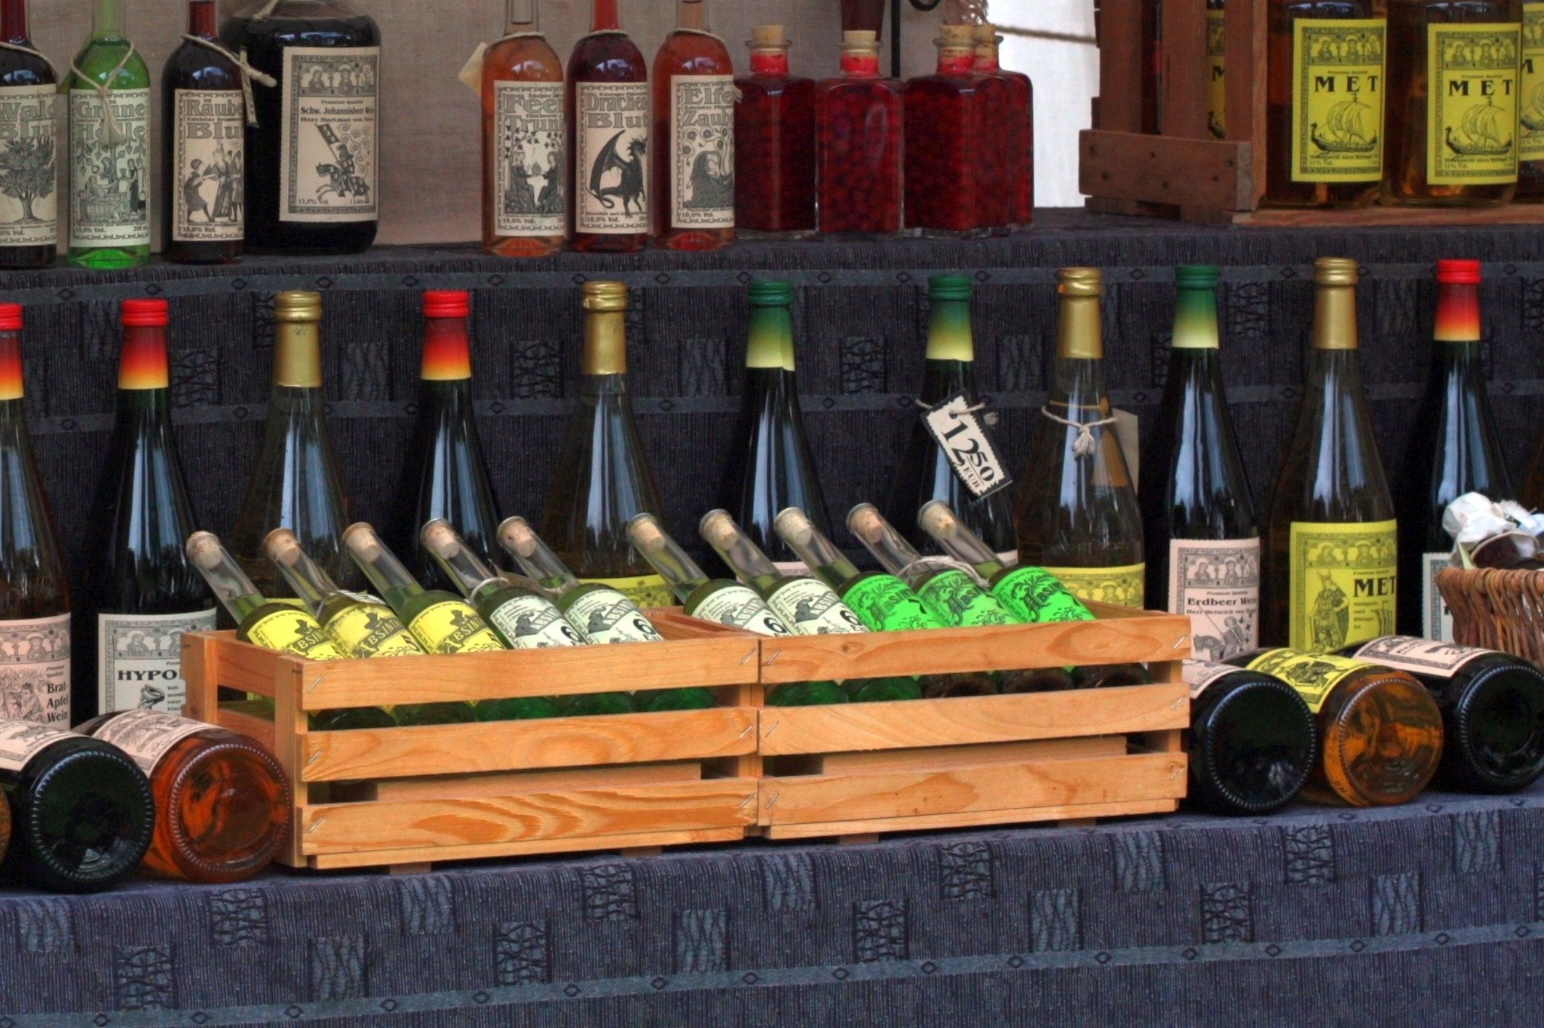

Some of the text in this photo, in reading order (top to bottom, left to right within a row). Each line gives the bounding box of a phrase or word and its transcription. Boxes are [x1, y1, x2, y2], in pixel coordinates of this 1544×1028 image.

[1314, 75, 1378, 93] MET
[1448, 79, 1513, 96] MET
[505, 115, 563, 132] Trun
[682, 109, 734, 126] Zaub
[186, 122, 242, 140] Blu
[964, 467, 981, 488] EUR
[1354, 575, 1396, 598] MET
[1187, 597, 1238, 607] Erdbeer
[764, 617, 787, 633] 6
[840, 610, 861, 625] 6
[561, 625, 582, 643] 6
[633, 618, 656, 635] 6
[118, 669, 178, 681] HYPO
[47, 695, 69, 710] Apfel
